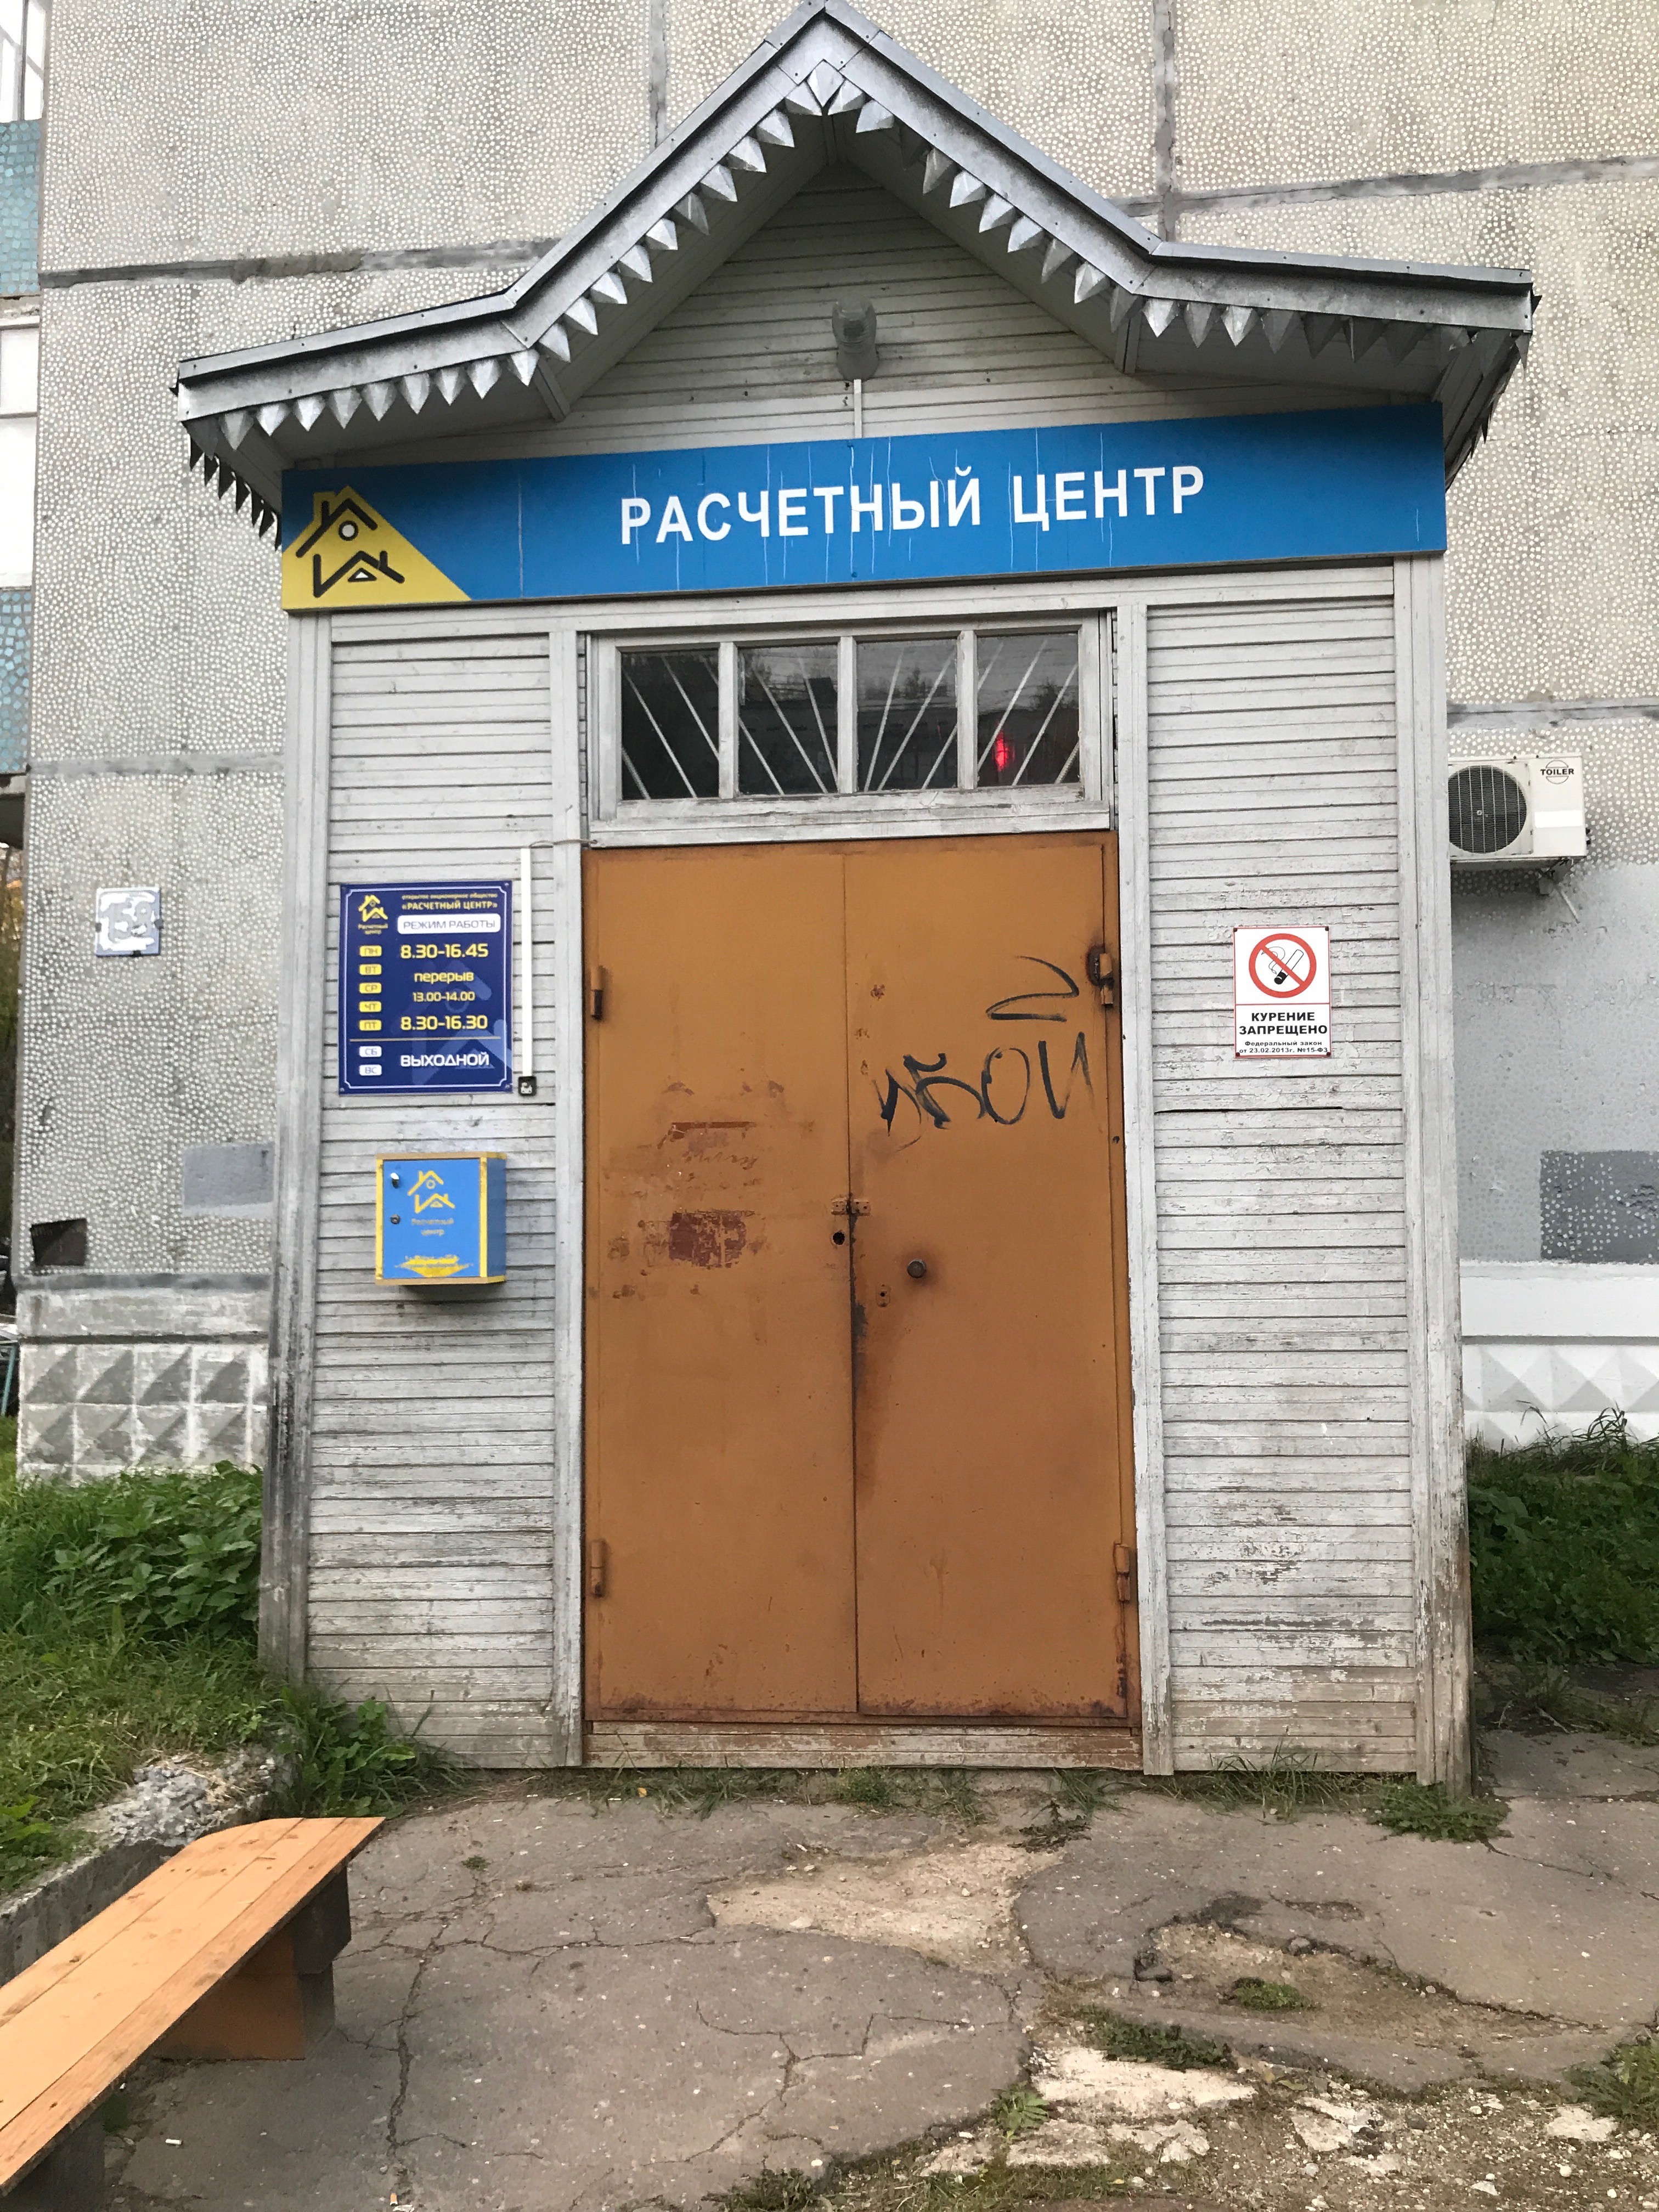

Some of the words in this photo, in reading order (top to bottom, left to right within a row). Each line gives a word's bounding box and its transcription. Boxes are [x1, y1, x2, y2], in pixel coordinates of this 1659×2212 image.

[622, 465, 980, 545] РАСЧЕТНЫЙ
[1013, 465, 1204, 531] ЦЕНТР
[402, 900, 461, 910] «РАСЧЕТНЫЙ
[463, 900, 498, 910] ЦЕНТР»
[403, 920, 447, 929] РЕЖИМ
[449, 919, 496, 929] РАБОТЫ
[400, 943, 488, 959] 8.30-16.45
[414, 972, 474, 984] перерыв
[413, 992, 476, 1002] 13.00-14.00
[400, 1015, 488, 1030] 8.30-16.30
[1251, 1012, 1315, 1022] КУРЕНИЕ
[1239, 1025, 1328, 1036] ЗАПРЕЩЕНО
[401, 1053, 489, 1068] ВЫХОДНОЙ
